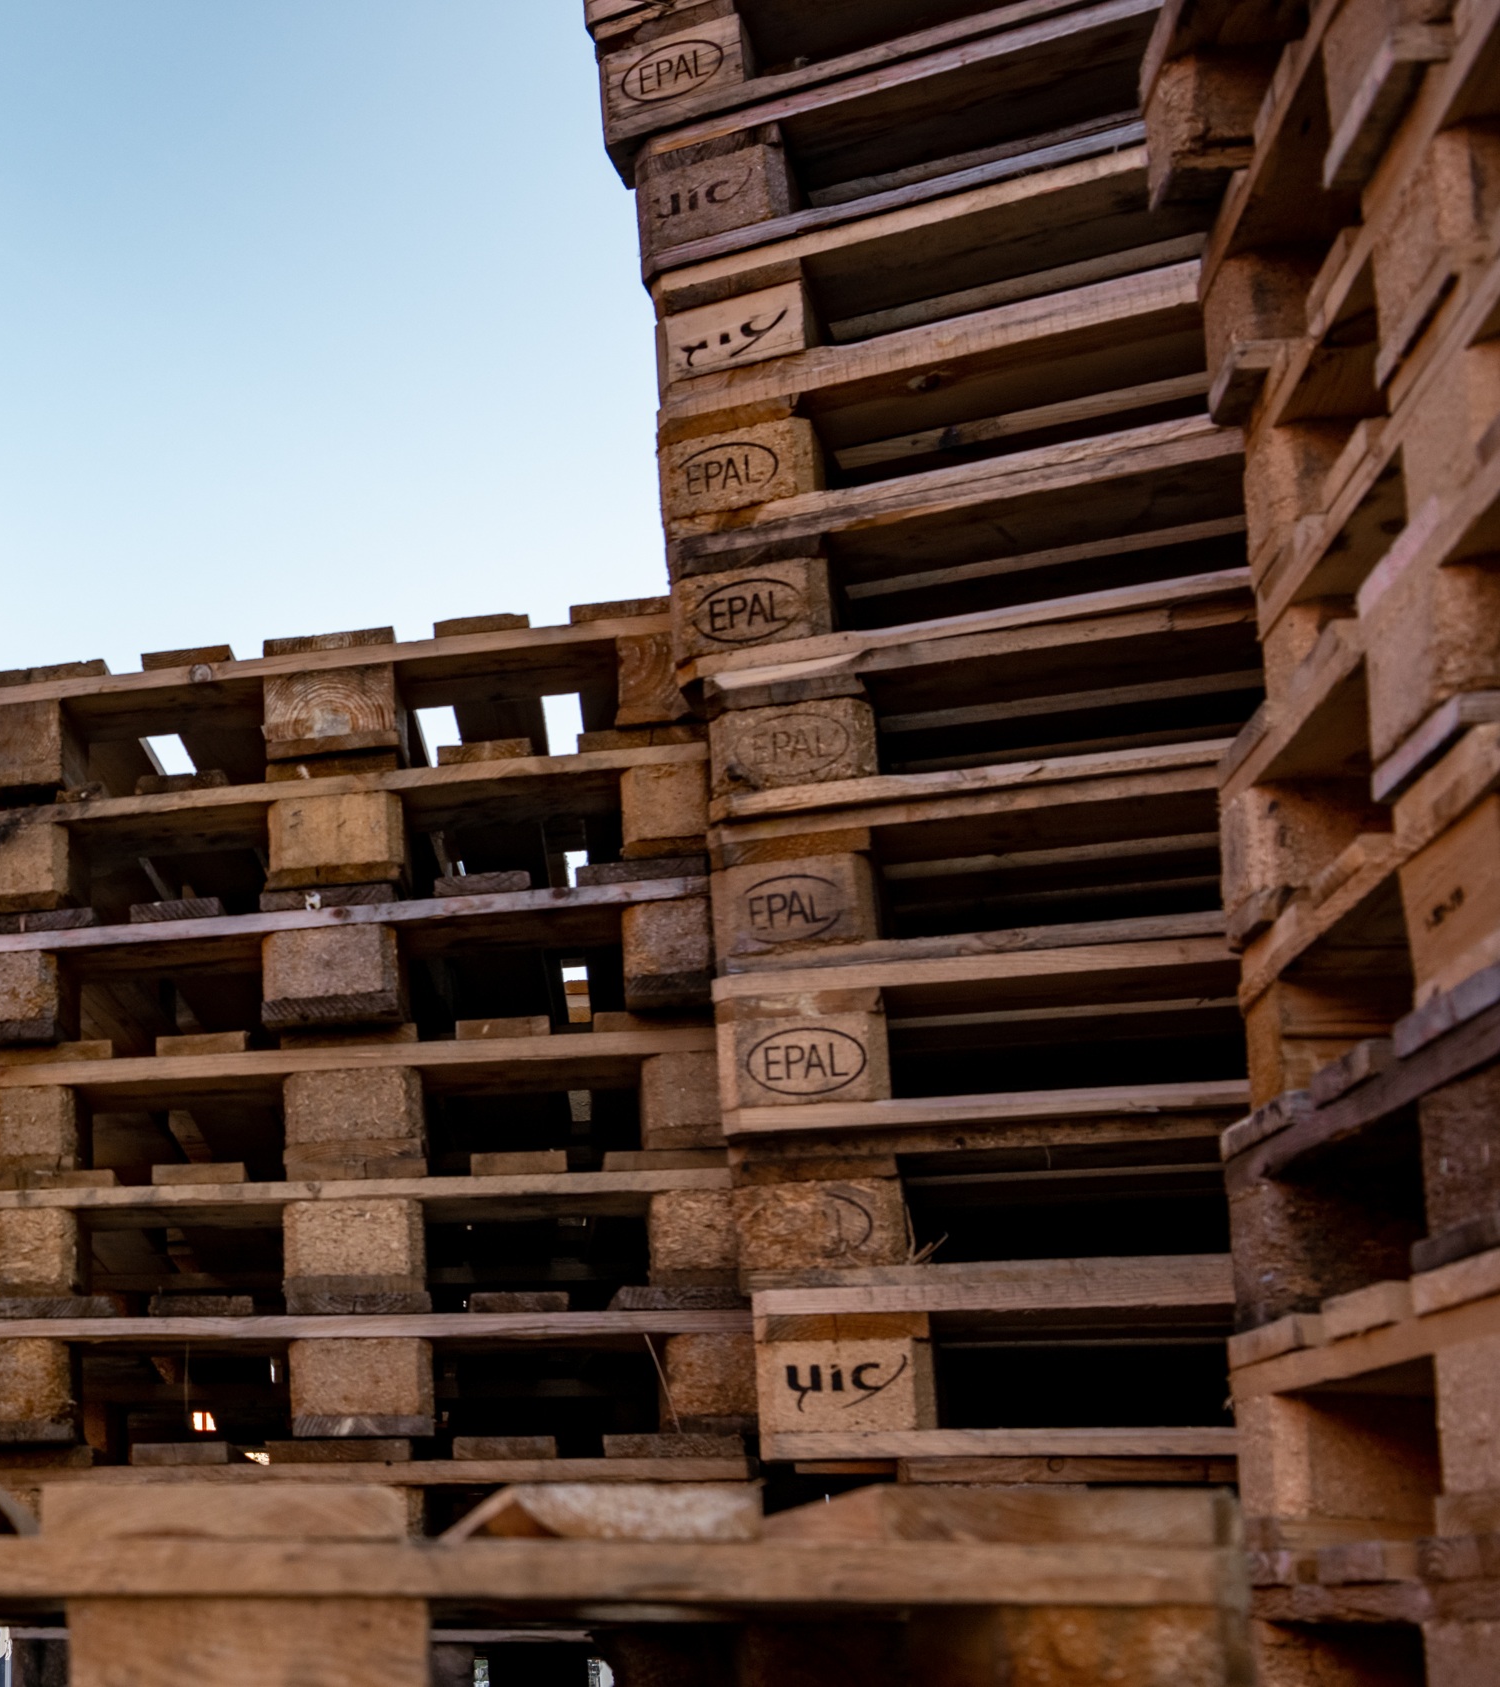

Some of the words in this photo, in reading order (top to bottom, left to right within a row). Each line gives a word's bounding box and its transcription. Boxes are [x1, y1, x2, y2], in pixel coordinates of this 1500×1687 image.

[638, 50, 709, 96] EPAL
[686, 454, 762, 496] EPAL
[708, 590, 788, 634] EPAL
[751, 726, 835, 767] EPAL
[749, 890, 830, 931] EPAL
[763, 1042, 849, 1082] EPAL
